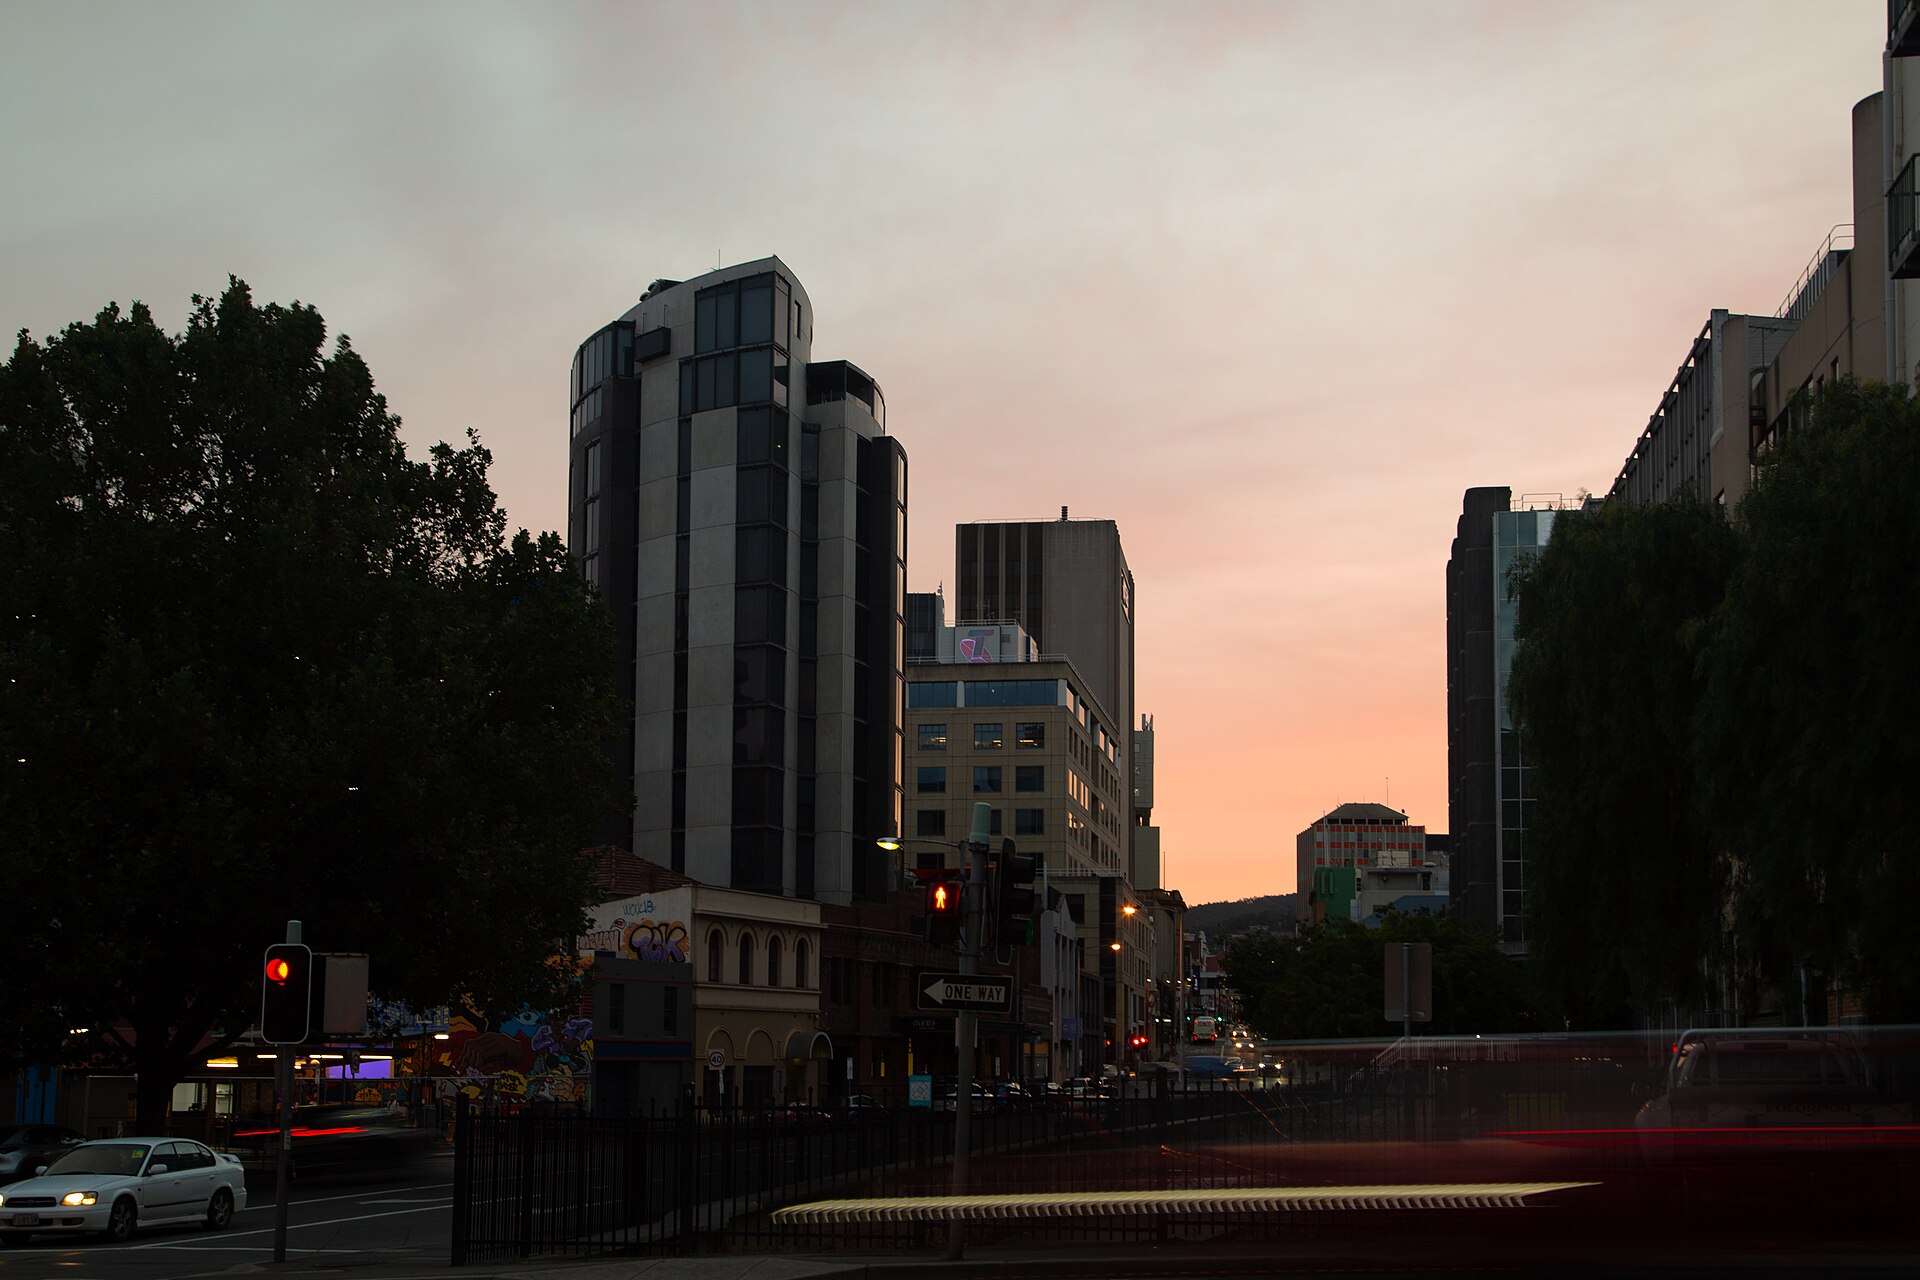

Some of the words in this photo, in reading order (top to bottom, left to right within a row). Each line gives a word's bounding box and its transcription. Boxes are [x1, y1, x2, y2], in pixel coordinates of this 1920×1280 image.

[945, 985, 971, 999] ONE
[978, 987, 1002, 1000] WAY
[712, 1055, 723, 1063] 40
